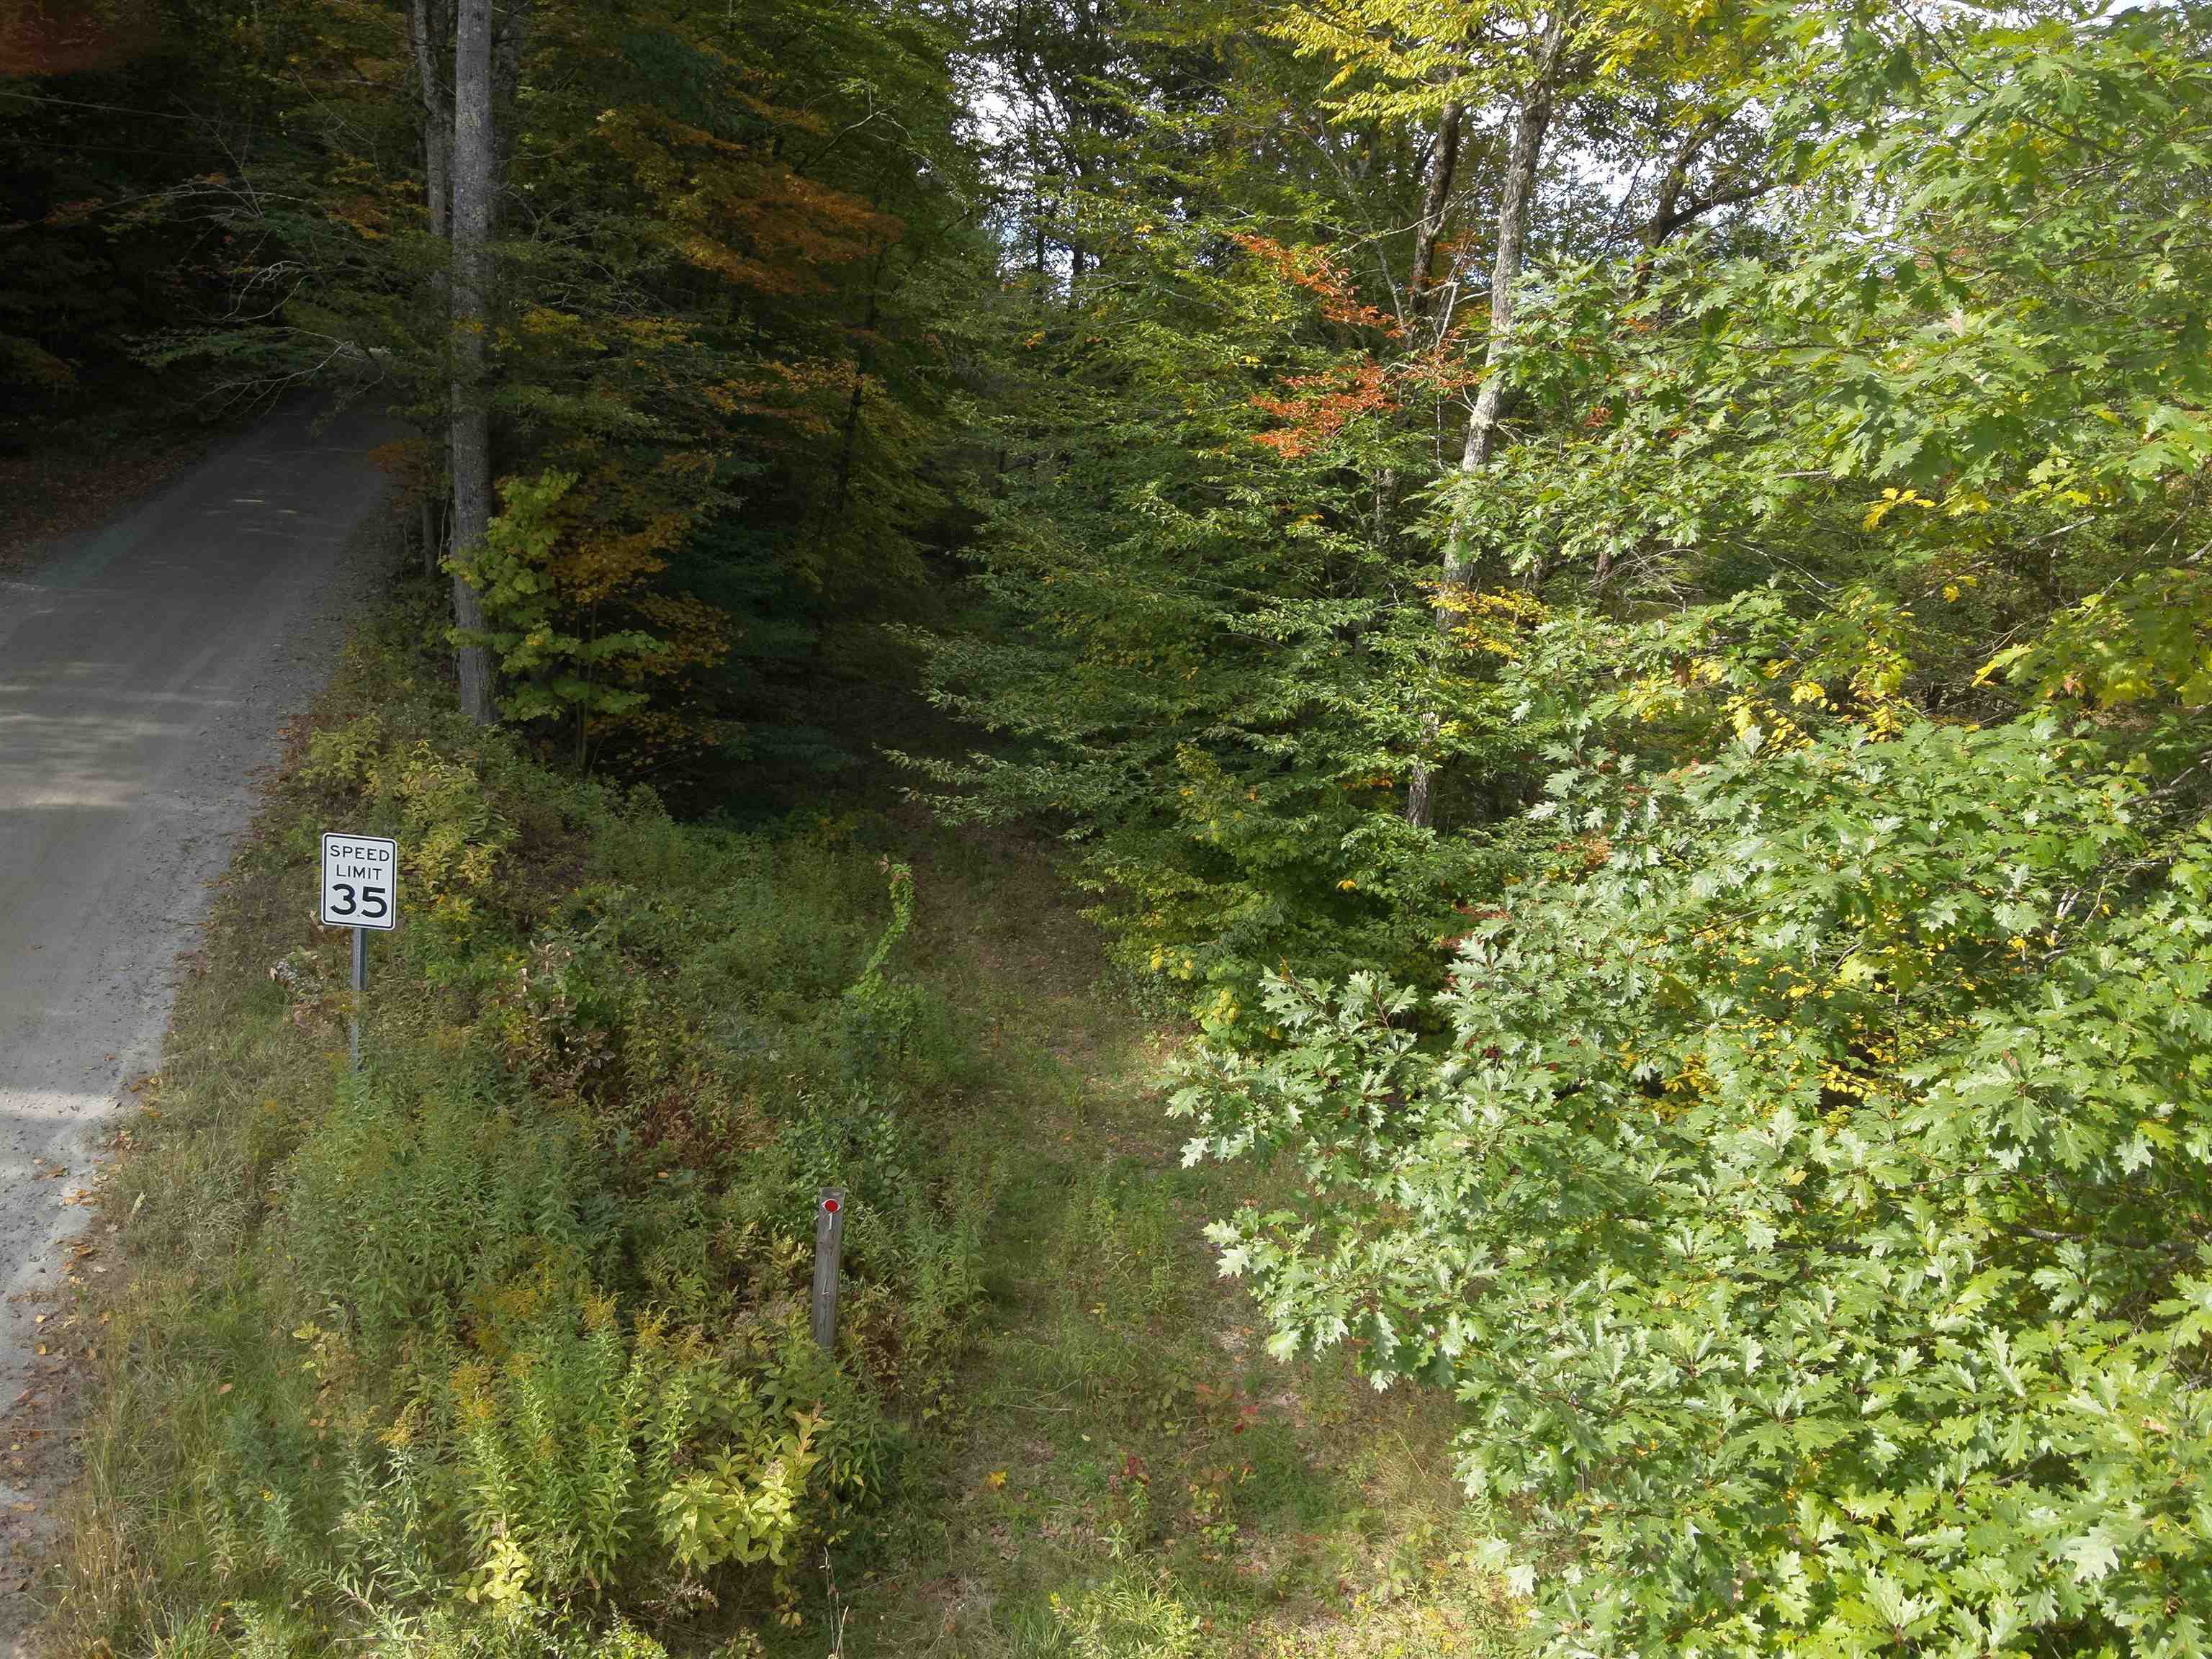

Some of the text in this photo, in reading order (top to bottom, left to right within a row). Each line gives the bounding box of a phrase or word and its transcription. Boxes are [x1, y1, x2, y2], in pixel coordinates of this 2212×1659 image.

[330, 845, 390, 862] SPEED
[336, 864, 382, 880] LIMIT
[330, 884, 387, 918] 35
